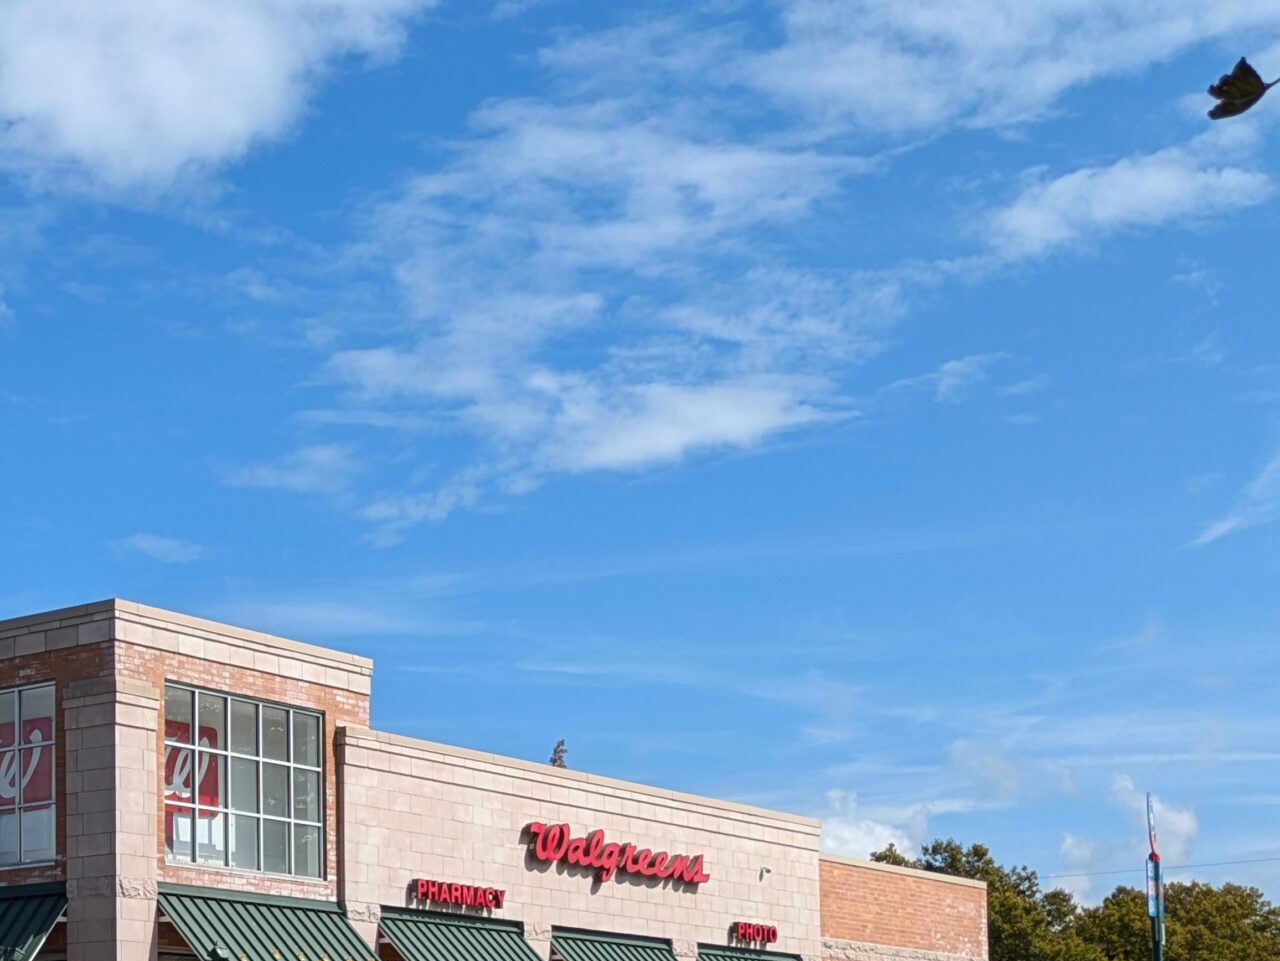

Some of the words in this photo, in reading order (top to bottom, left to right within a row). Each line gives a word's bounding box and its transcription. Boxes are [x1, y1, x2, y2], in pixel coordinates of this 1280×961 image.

[531, 822, 711, 883] Walgreens
[417, 879, 506, 909] PHARMACY
[738, 922, 778, 943] PHOTO
